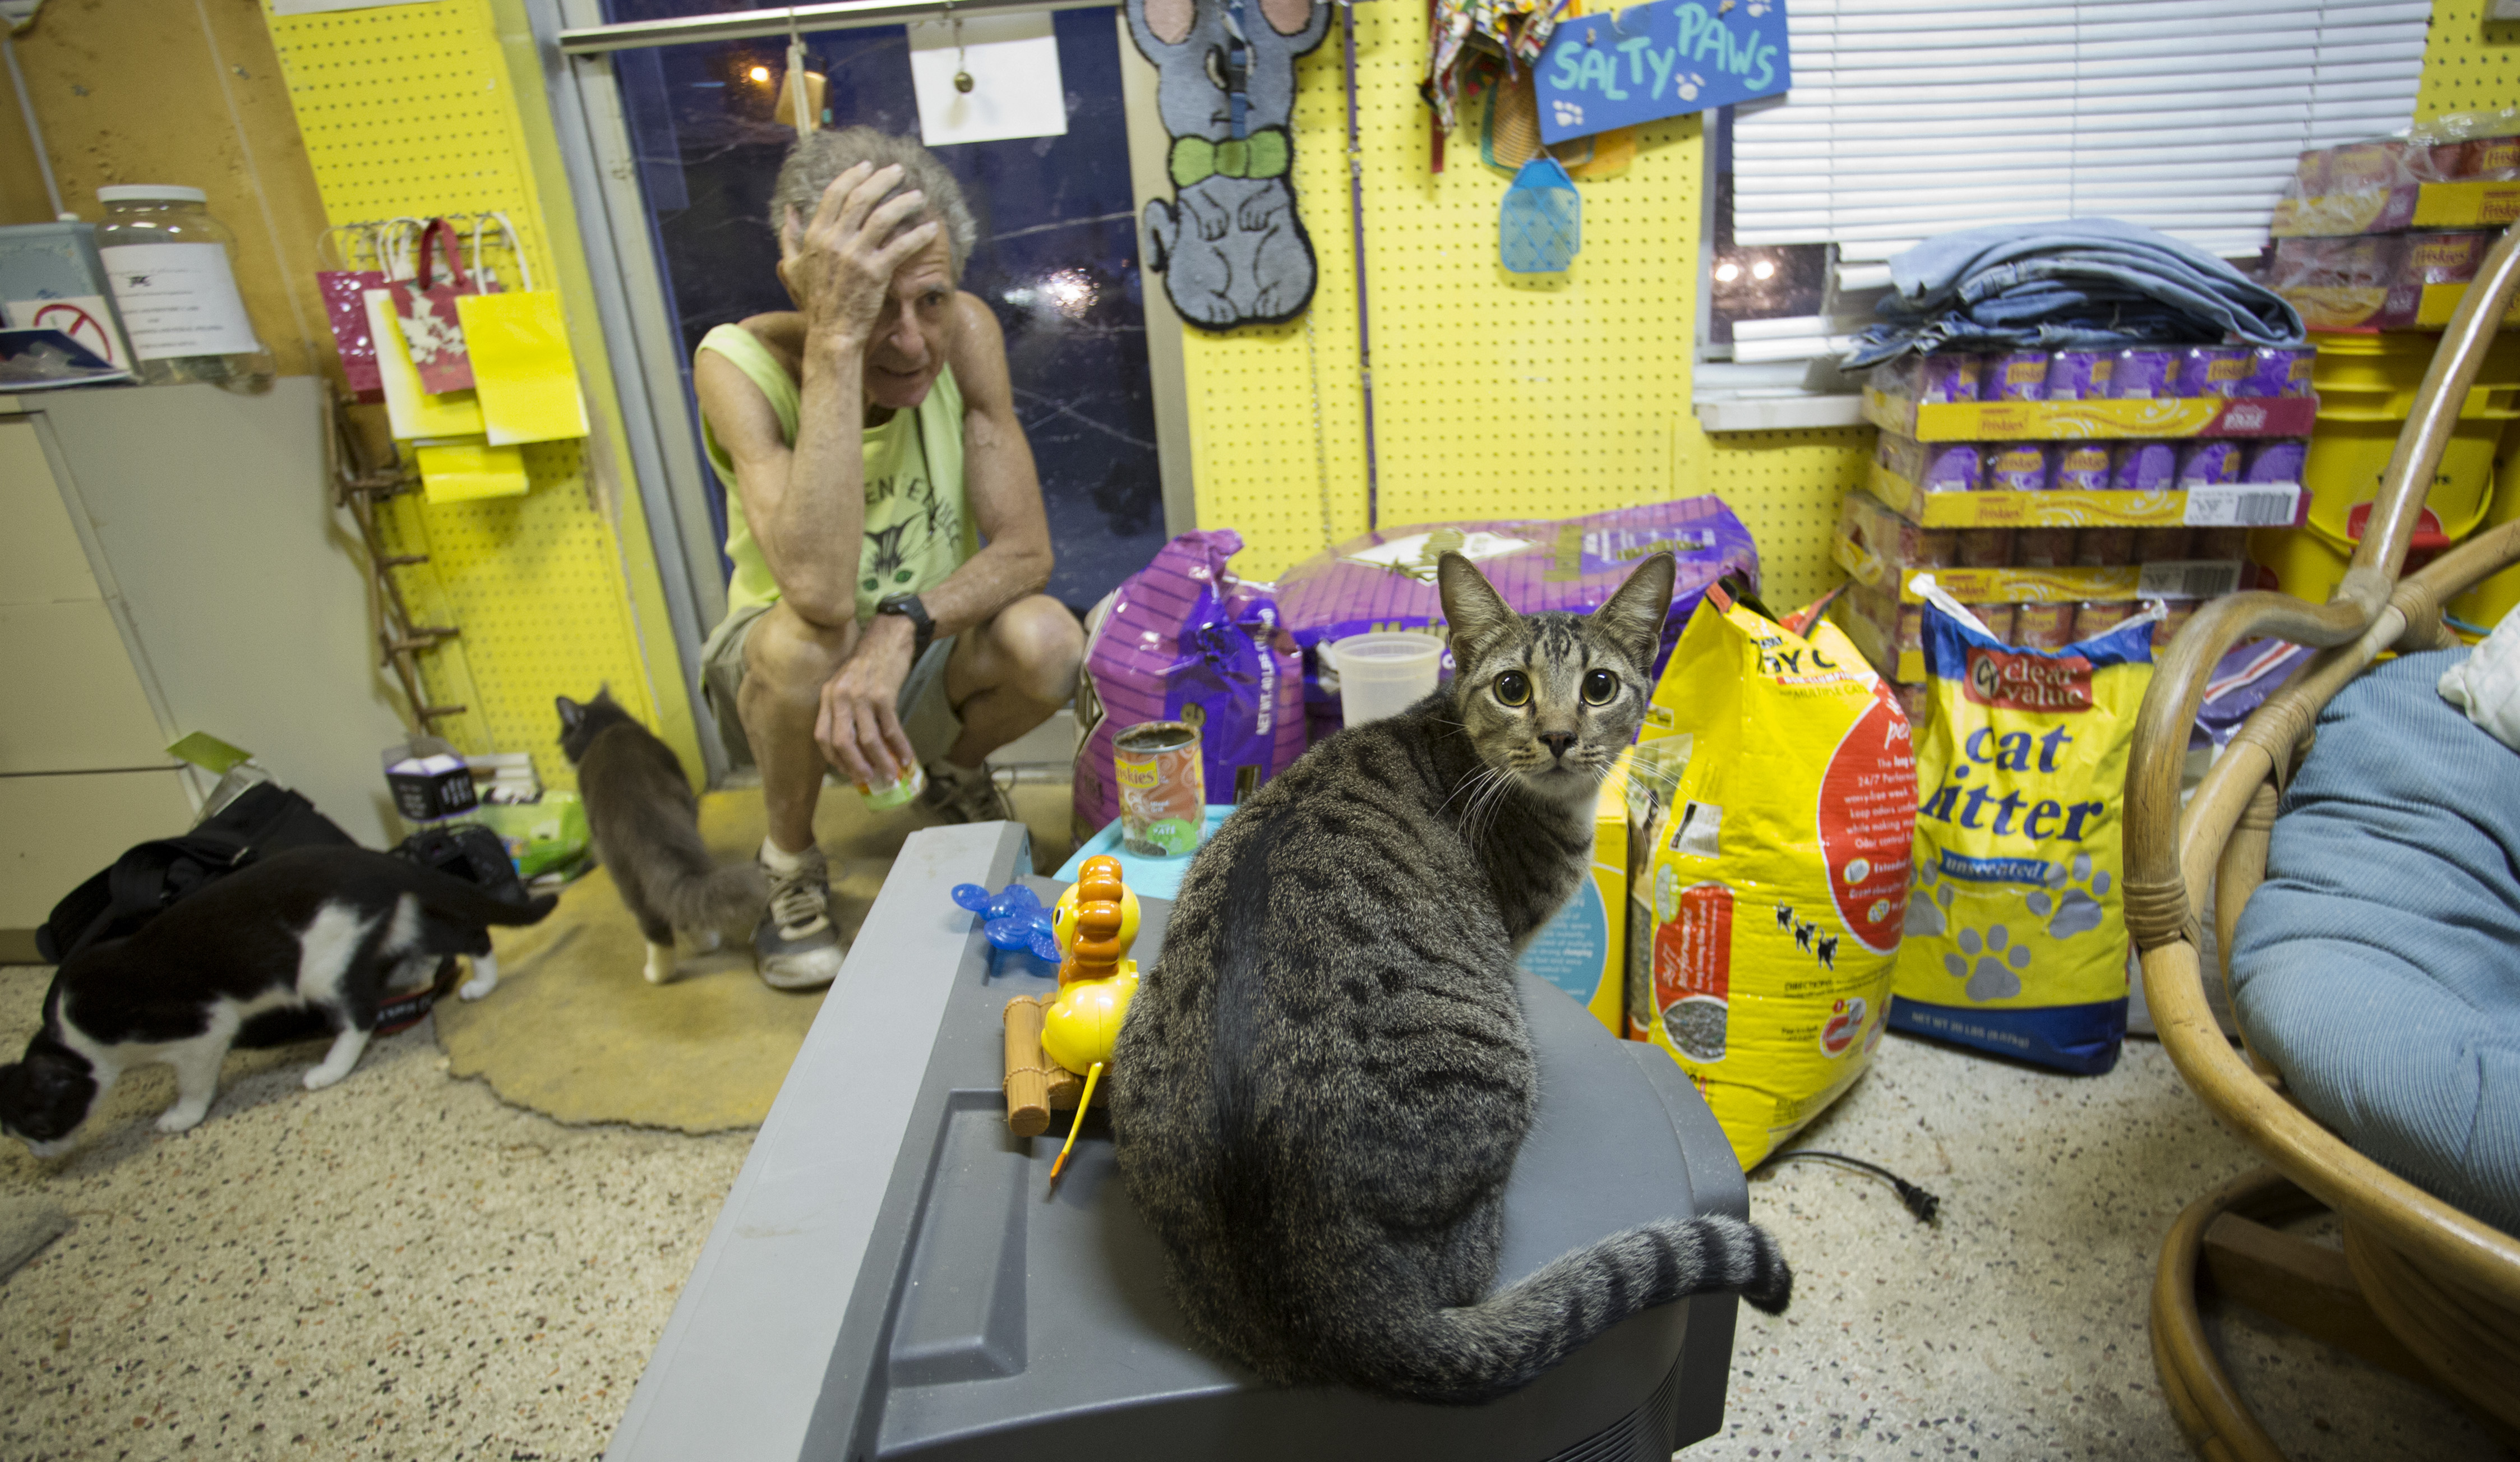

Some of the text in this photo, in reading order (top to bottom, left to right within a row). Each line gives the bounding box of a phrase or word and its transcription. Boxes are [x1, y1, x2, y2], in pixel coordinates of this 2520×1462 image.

[1549, 2, 1778, 101] SALTY PAWS
[2003, 658, 2078, 685] clear
[2002, 680, 2084, 706] value
[1965, 723, 2073, 774] cat
[1945, 857, 2043, 880] unscented
[1911, 1011, 1931, 1026] NET
